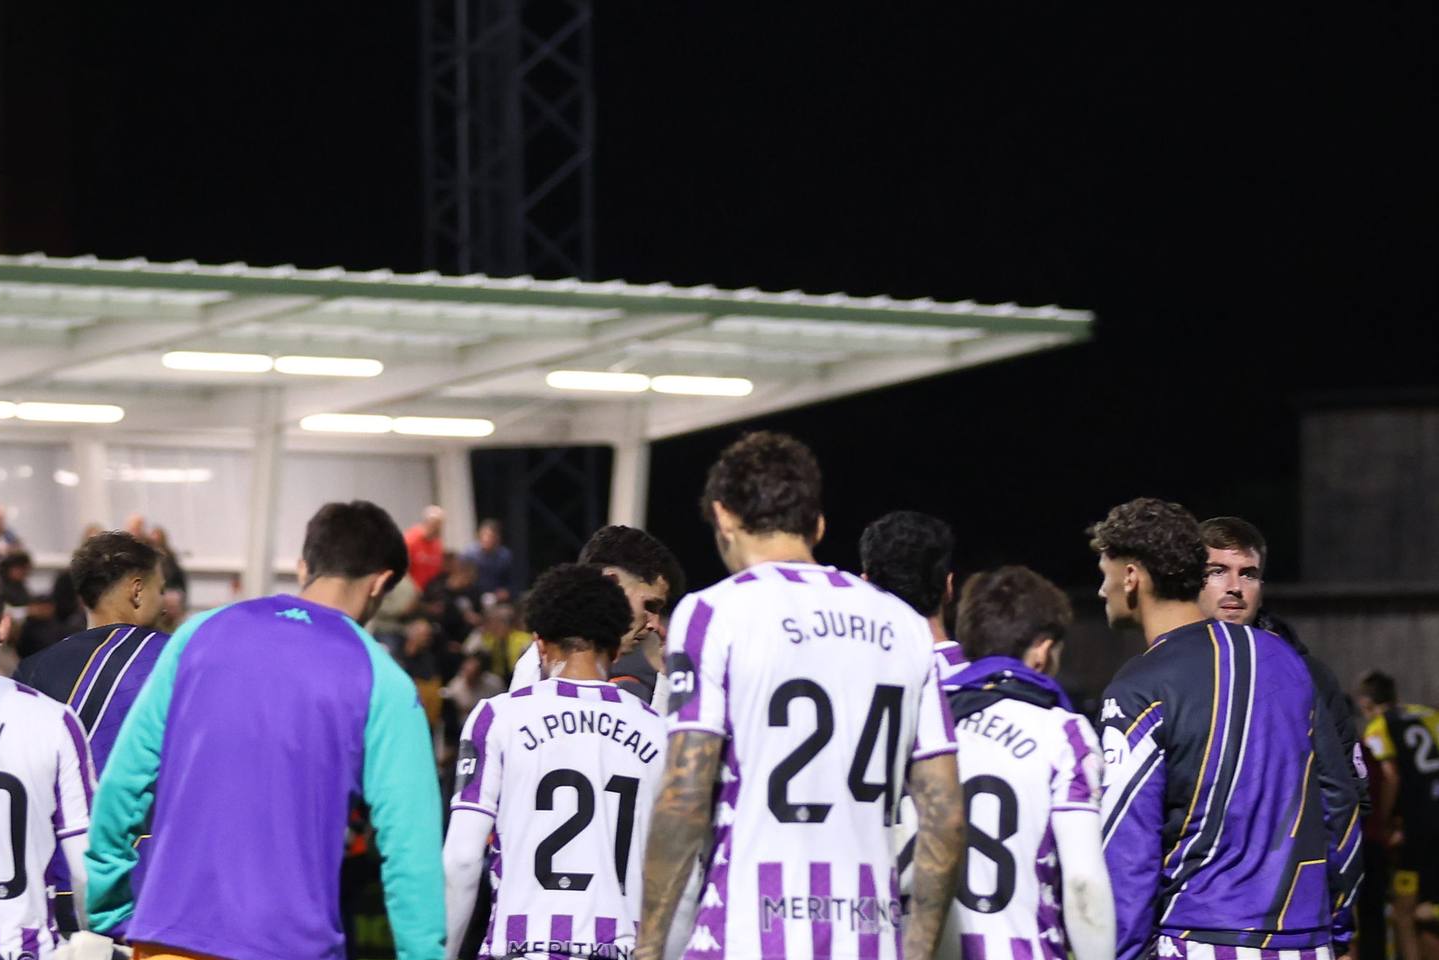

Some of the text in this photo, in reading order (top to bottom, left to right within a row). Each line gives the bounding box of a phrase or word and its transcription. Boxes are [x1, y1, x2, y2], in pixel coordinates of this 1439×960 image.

[669, 671, 694, 693] GI
[519, 710, 658, 764] J.PONCEAU
[767, 678, 904, 827] 24
[963, 710, 1037, 759] RENO
[1104, 748, 1123, 764] GI
[1403, 723, 1439, 774] 2
[456, 758, 477, 775] GI
[535, 769, 640, 896] 21
[958, 775, 1018, 914] 8
